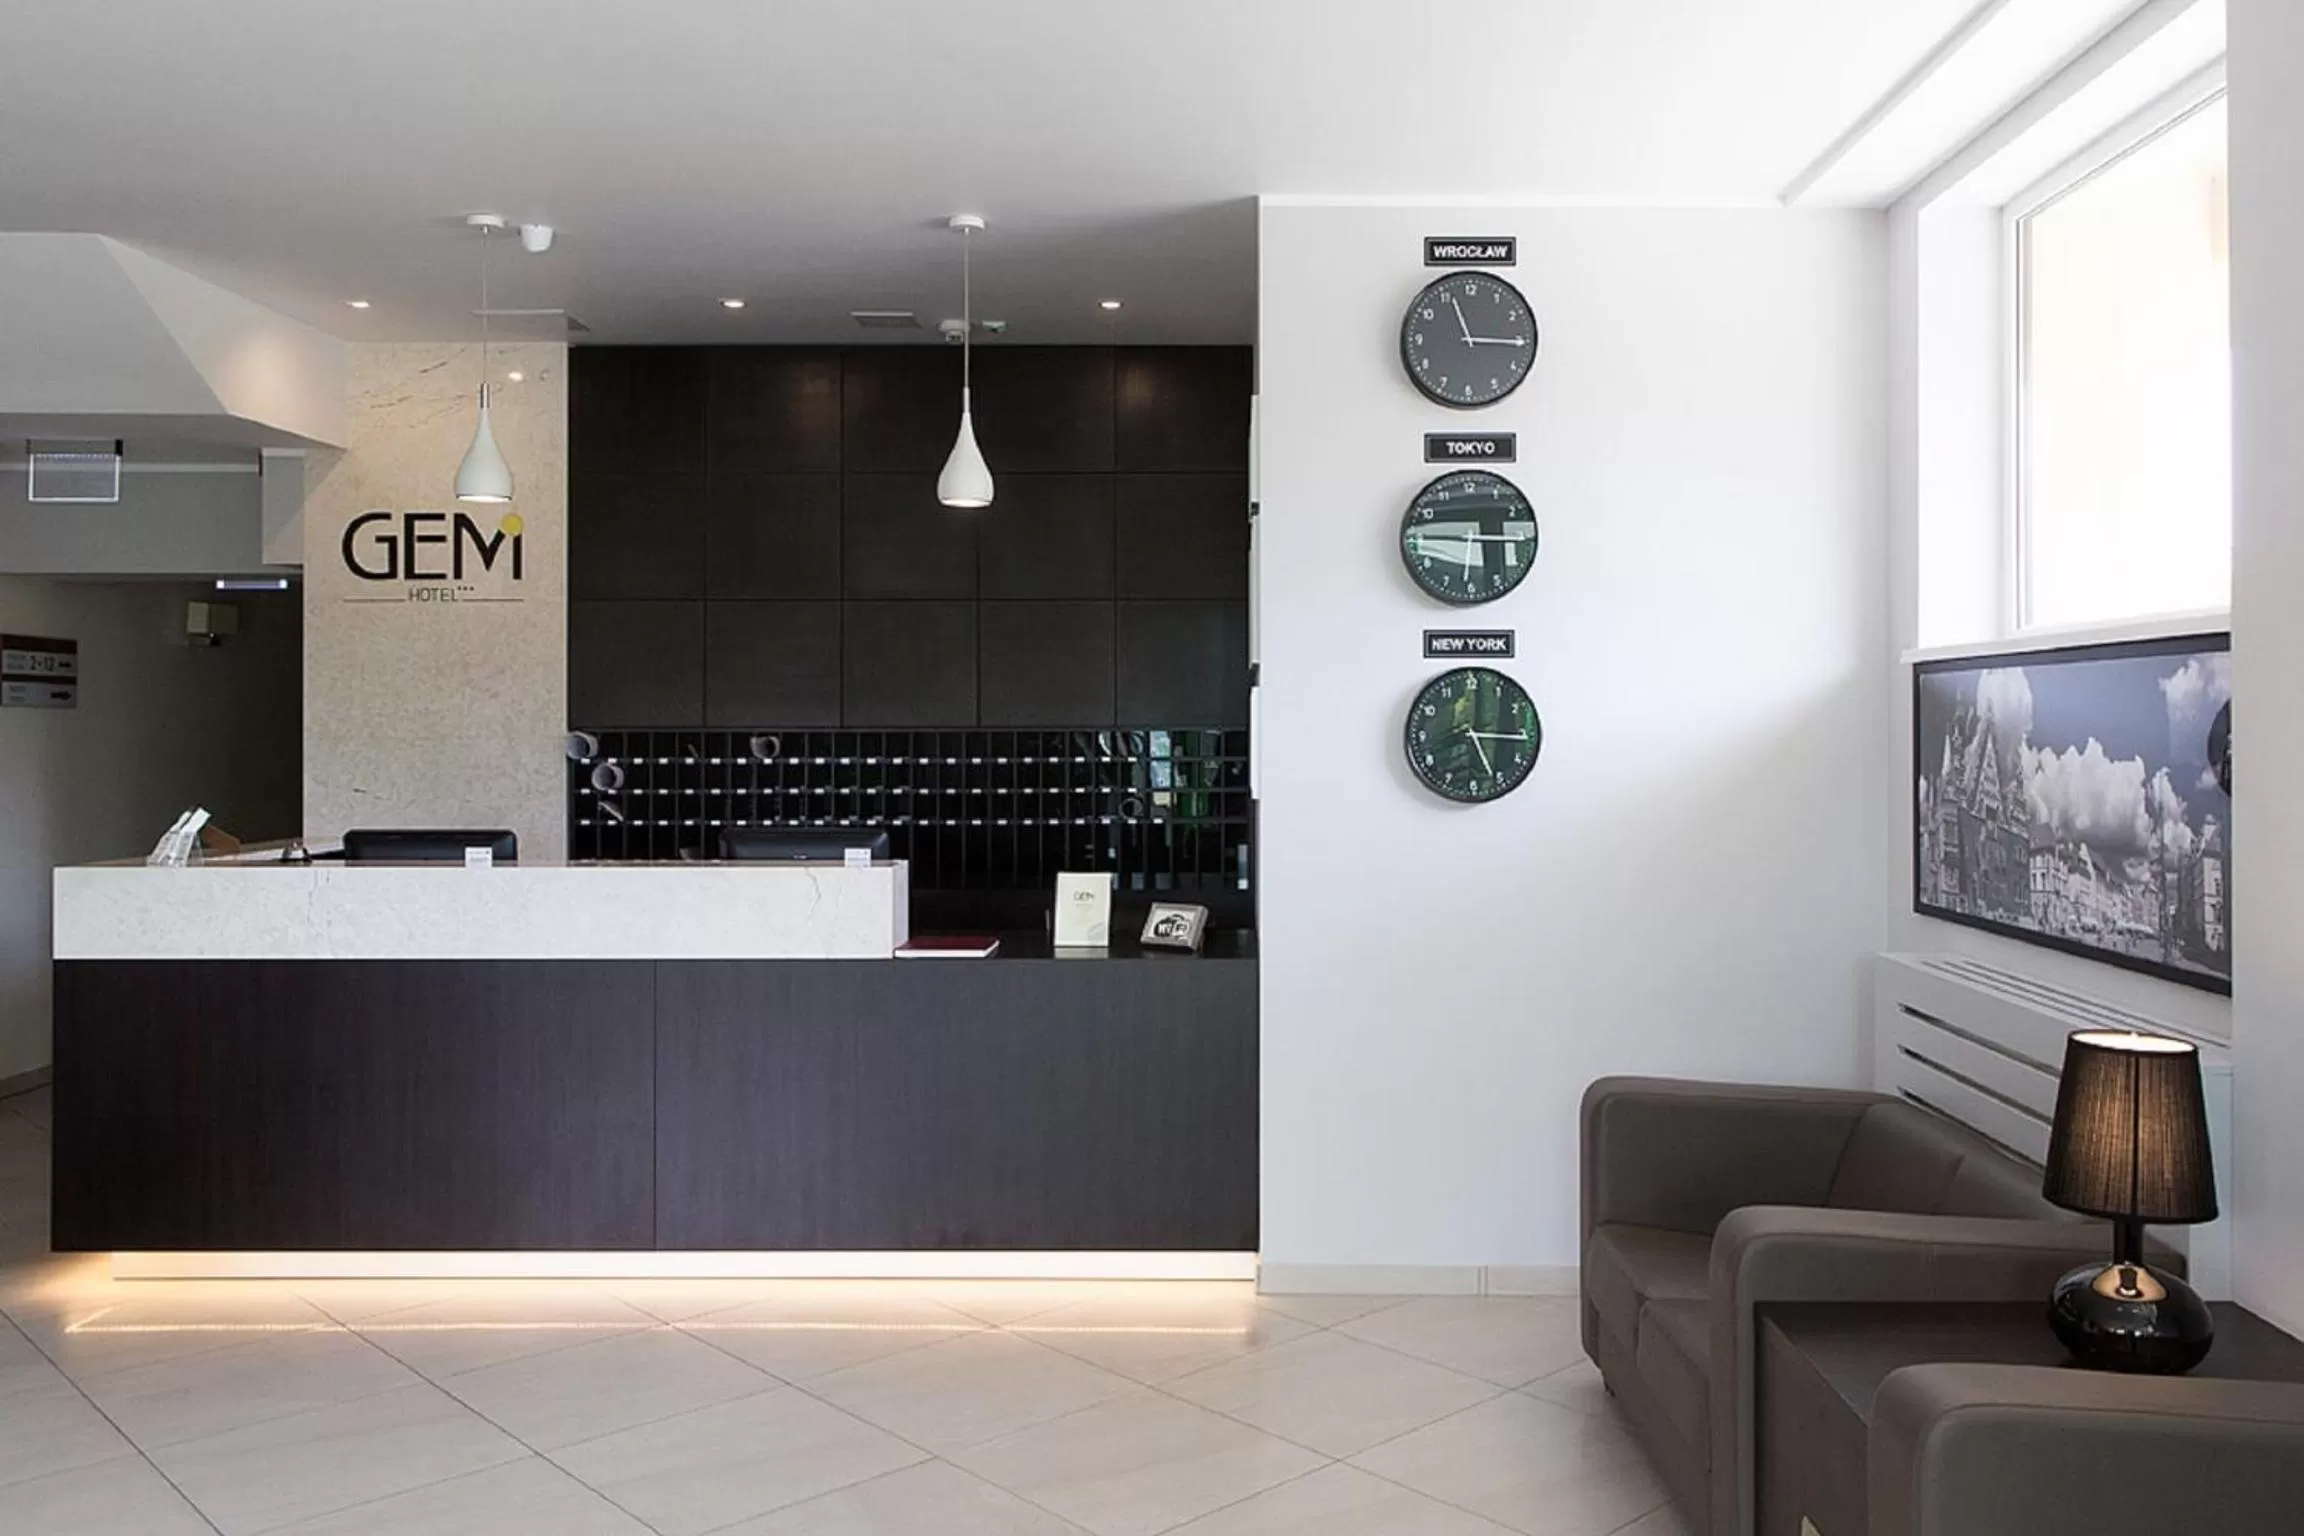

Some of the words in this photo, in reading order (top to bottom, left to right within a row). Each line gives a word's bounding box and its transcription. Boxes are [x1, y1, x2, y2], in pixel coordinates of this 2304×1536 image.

[1465, 284, 1477, 295] 12
[1441, 292, 1450, 303] 11
[1494, 293, 1500, 303] 1
[1423, 308, 1434, 320] 10
[1509, 311, 1517, 321] 2
[1415, 334, 1423, 345] 9
[1440, 376, 1447, 388] 7
[1465, 385, 1472, 395] 6
[1446, 442, 1495, 454] TOKYO
[1464, 483, 1475, 493] 12
[1423, 508, 1434, 519] 10
[1509, 506, 1516, 517] 2
[1468, 583, 1475, 593] 6
[1432, 638, 1465, 650] NEW
[1466, 638, 1507, 650] YORK
[1466, 678, 1478, 689] 12
[1442, 687, 1451, 698] 11
[1496, 687, 1501, 697] 1
[1511, 704, 1518, 714] 2
[1419, 731, 1426, 742] 9
[1445, 772, 1453, 783] 7
[1496, 772, 1504, 783] 5
[1470, 780, 1478, 790] 6
